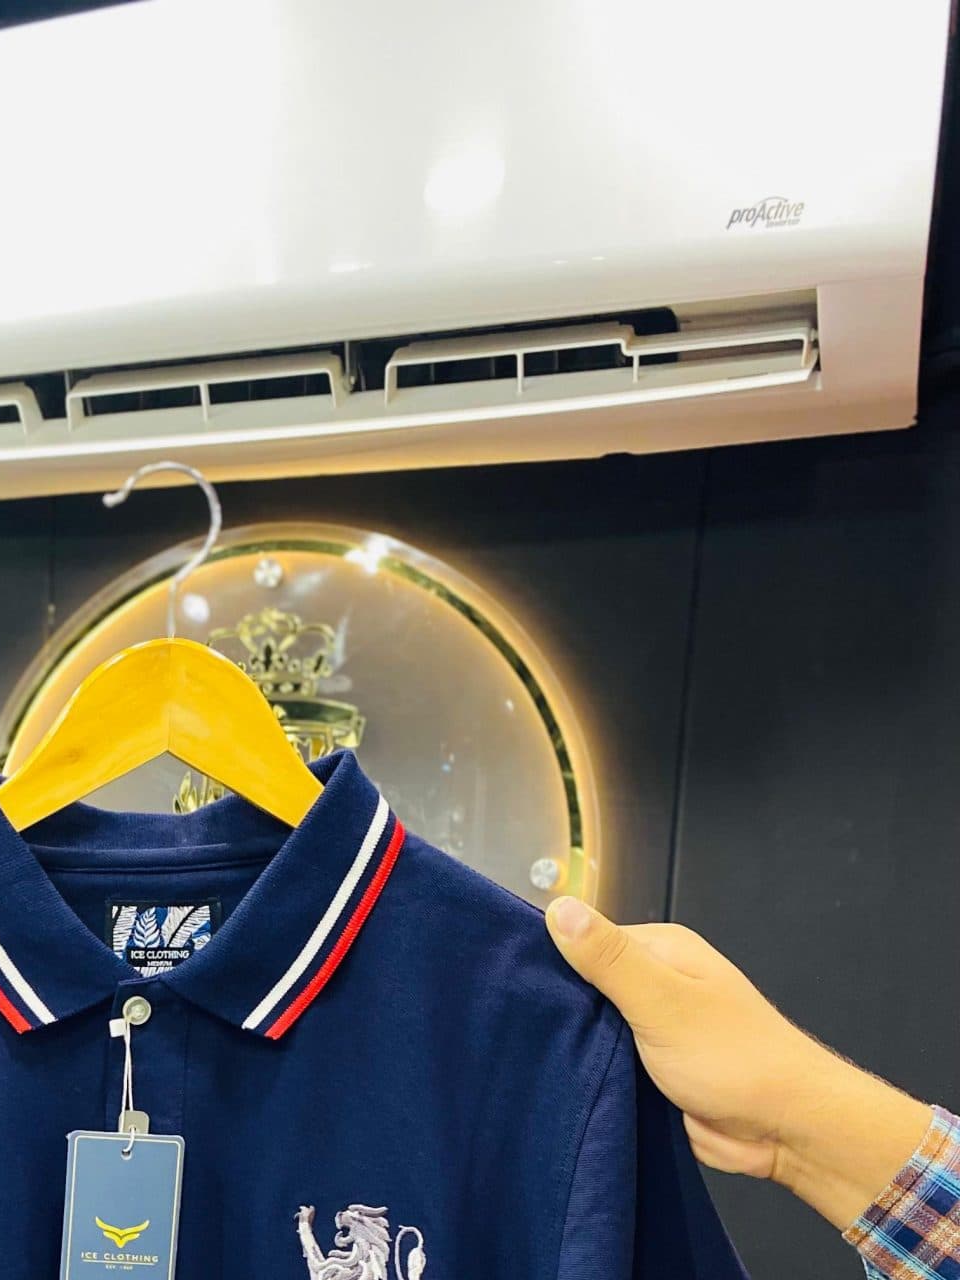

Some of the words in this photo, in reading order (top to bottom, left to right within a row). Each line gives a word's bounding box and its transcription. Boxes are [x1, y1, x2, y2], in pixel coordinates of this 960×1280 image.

[725, 200, 804, 230] proActive
[131, 950, 145, 959] ICE
[146, 950, 190, 959] CLOTHING
[81, 1251, 98, 1259] ICE
[103, 1252, 159, 1263] CLOTHING
